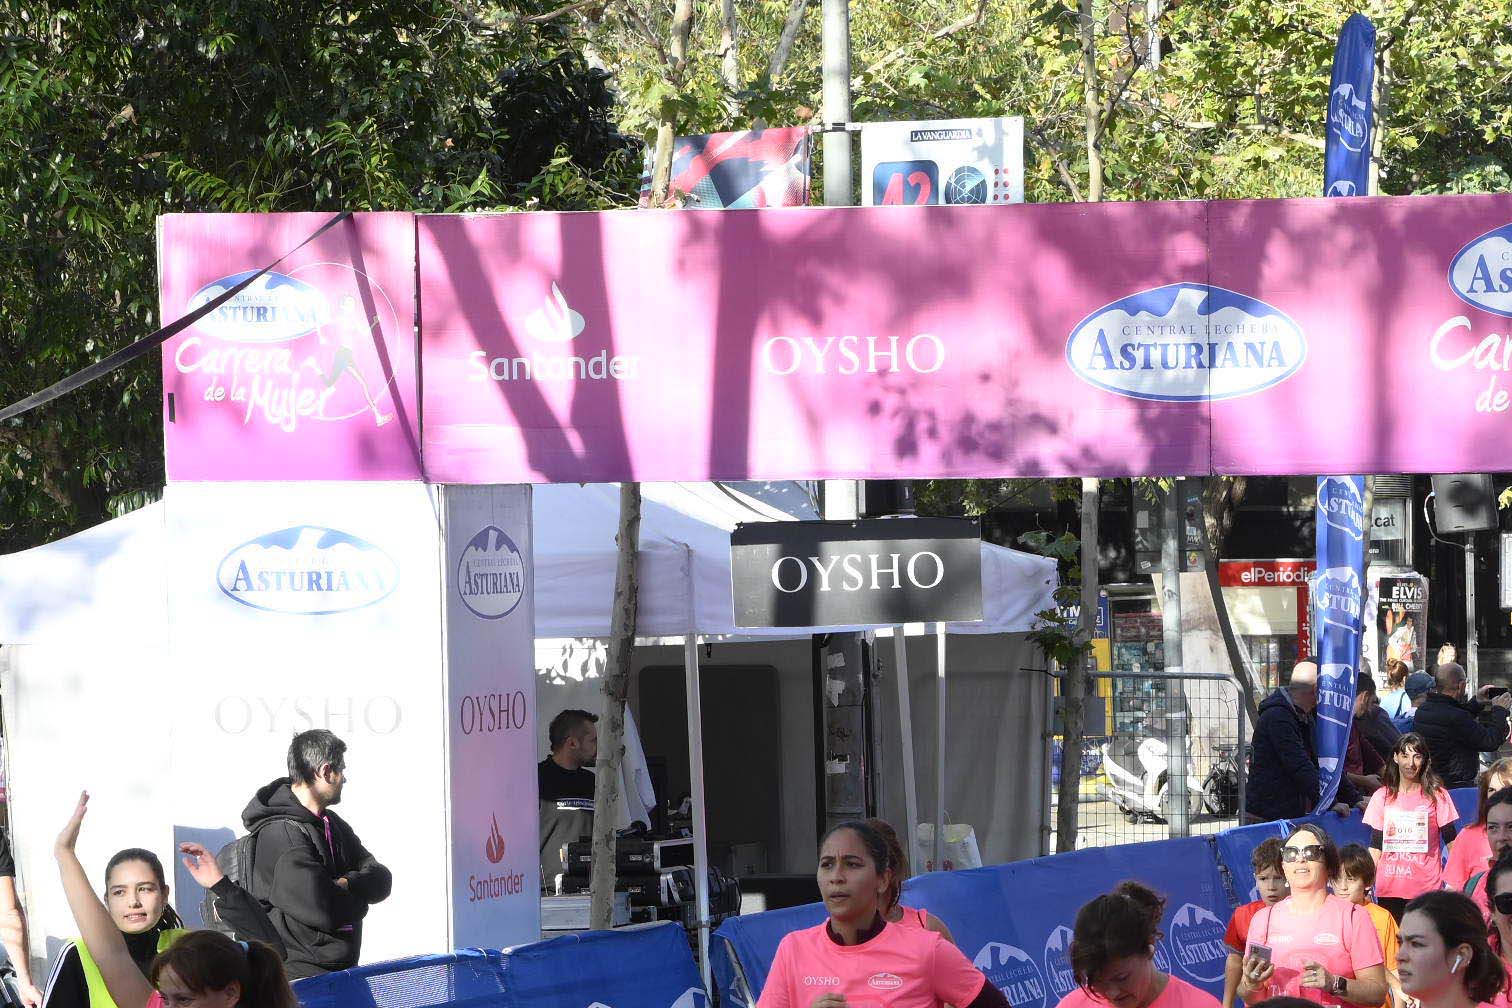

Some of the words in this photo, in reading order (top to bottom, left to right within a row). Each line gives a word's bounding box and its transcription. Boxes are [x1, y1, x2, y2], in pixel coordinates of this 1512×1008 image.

[924, 129, 972, 141] VANGUARDIA
[1122, 324, 1198, 336] CENTRAL
[174, 336, 293, 375] Carrera
[469, 348, 642, 382] Santander
[763, 333, 946, 376] OYSHO
[1087, 328, 1288, 371] ASTURIANA
[204, 375, 226, 402] de
[230, 374, 245, 401] la
[243, 371, 337, 432] Mujer
[1475, 377, 1510, 413] de
[463, 561, 521, 597] ASTURIANA
[772, 551, 945, 593] OYSHO
[1391, 586, 1423, 599] ELVIS
[214, 694, 403, 736] OYSHO
[461, 690, 527, 735] OYSHO
[469, 868, 525, 902] Santander
[804, 976, 841, 986] OYSHO
